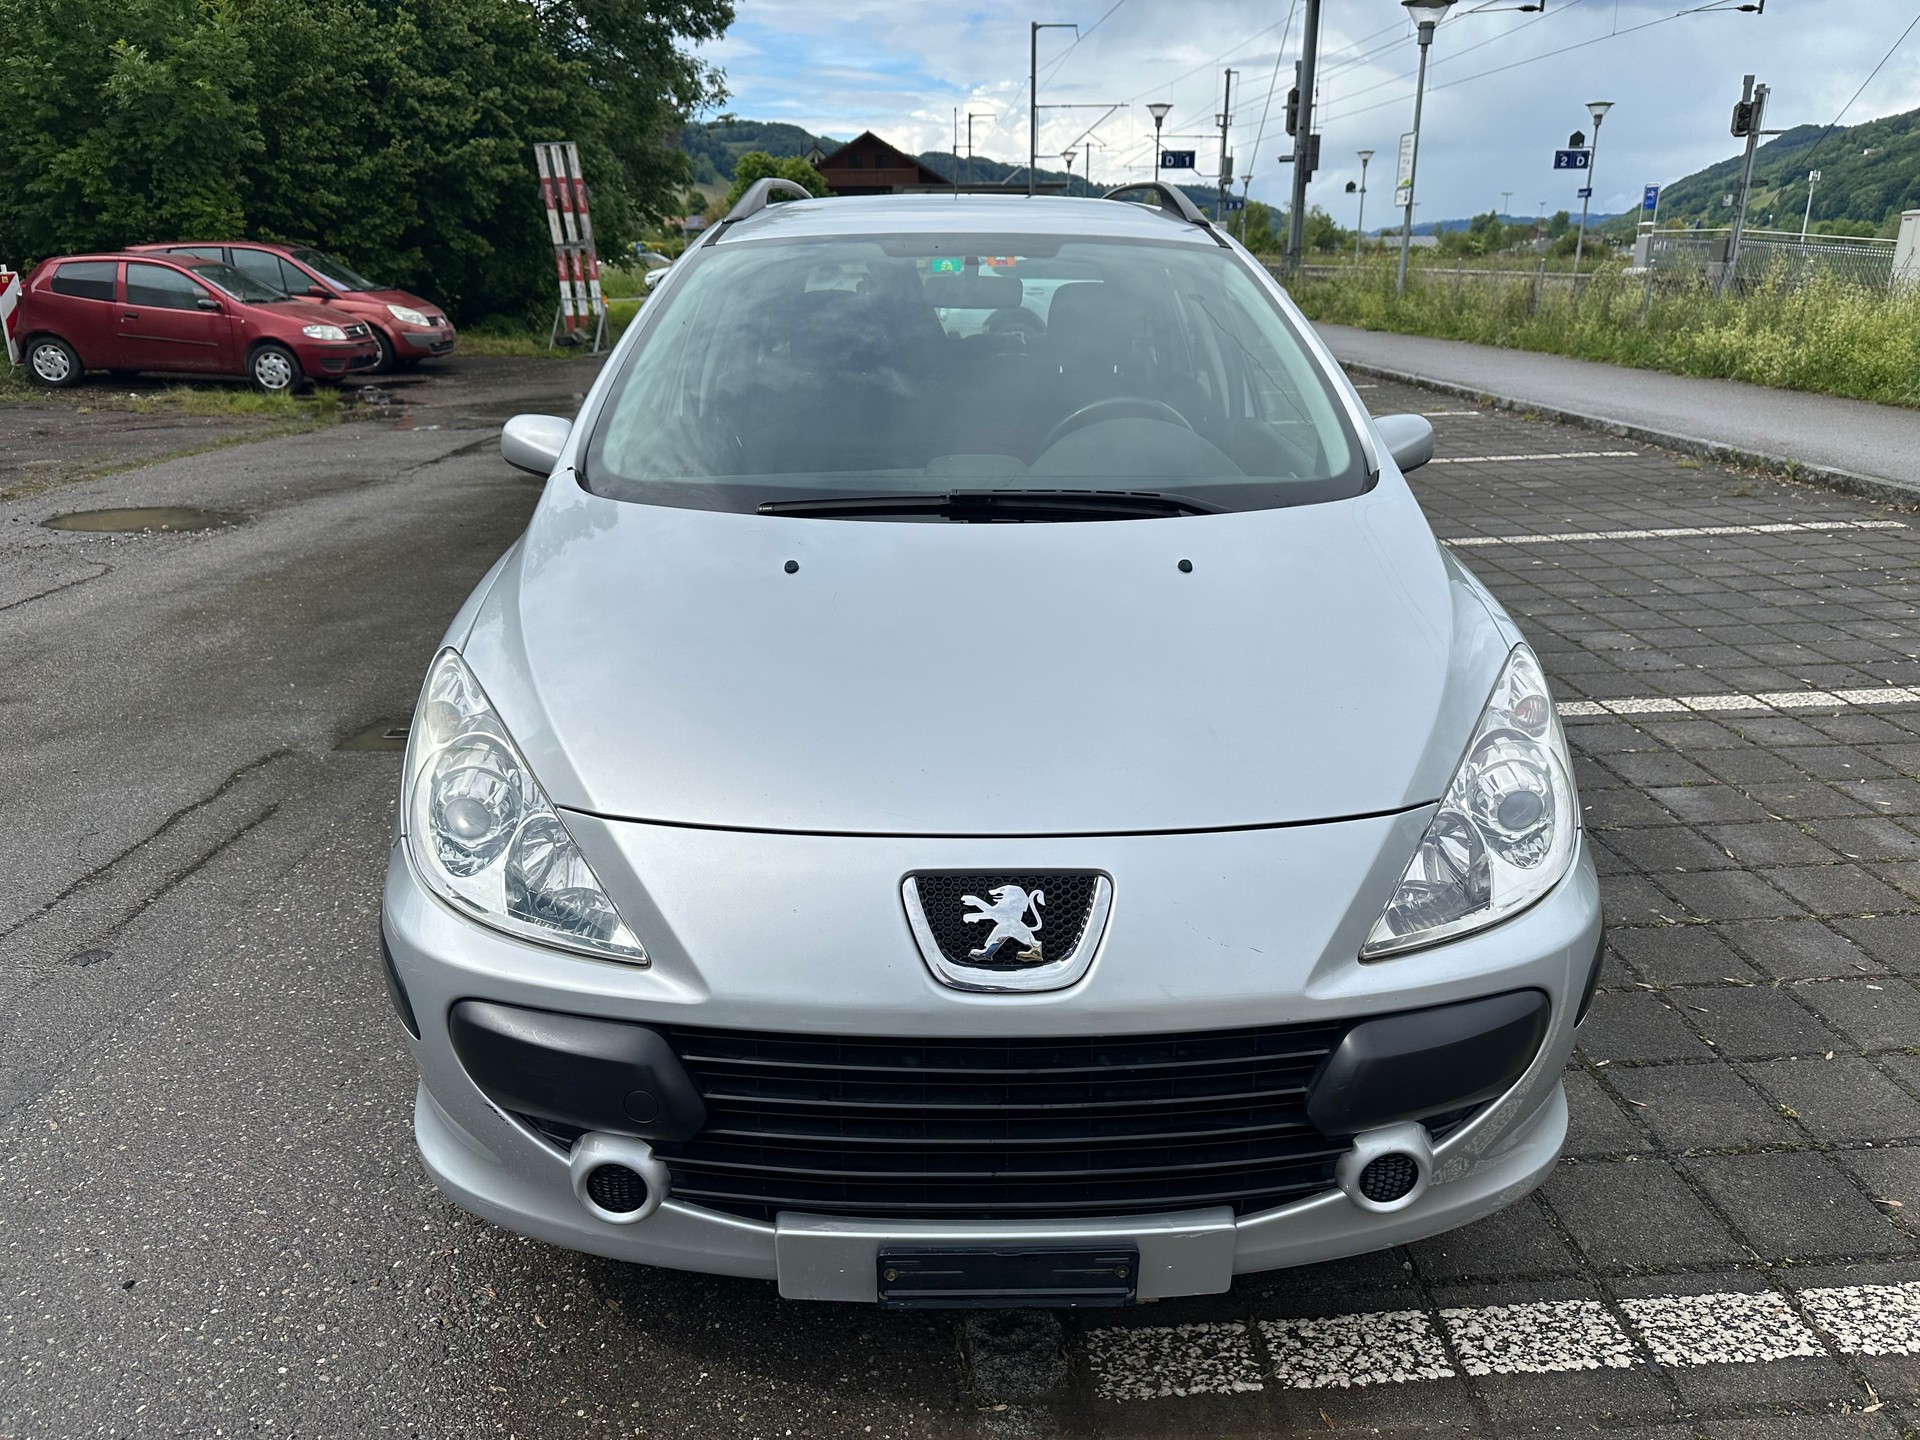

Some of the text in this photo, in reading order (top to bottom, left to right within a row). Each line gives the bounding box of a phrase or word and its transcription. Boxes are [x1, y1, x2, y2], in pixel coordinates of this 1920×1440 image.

[1165, 155, 1190, 167] D 1
[1560, 156, 1585, 167] 2 D
